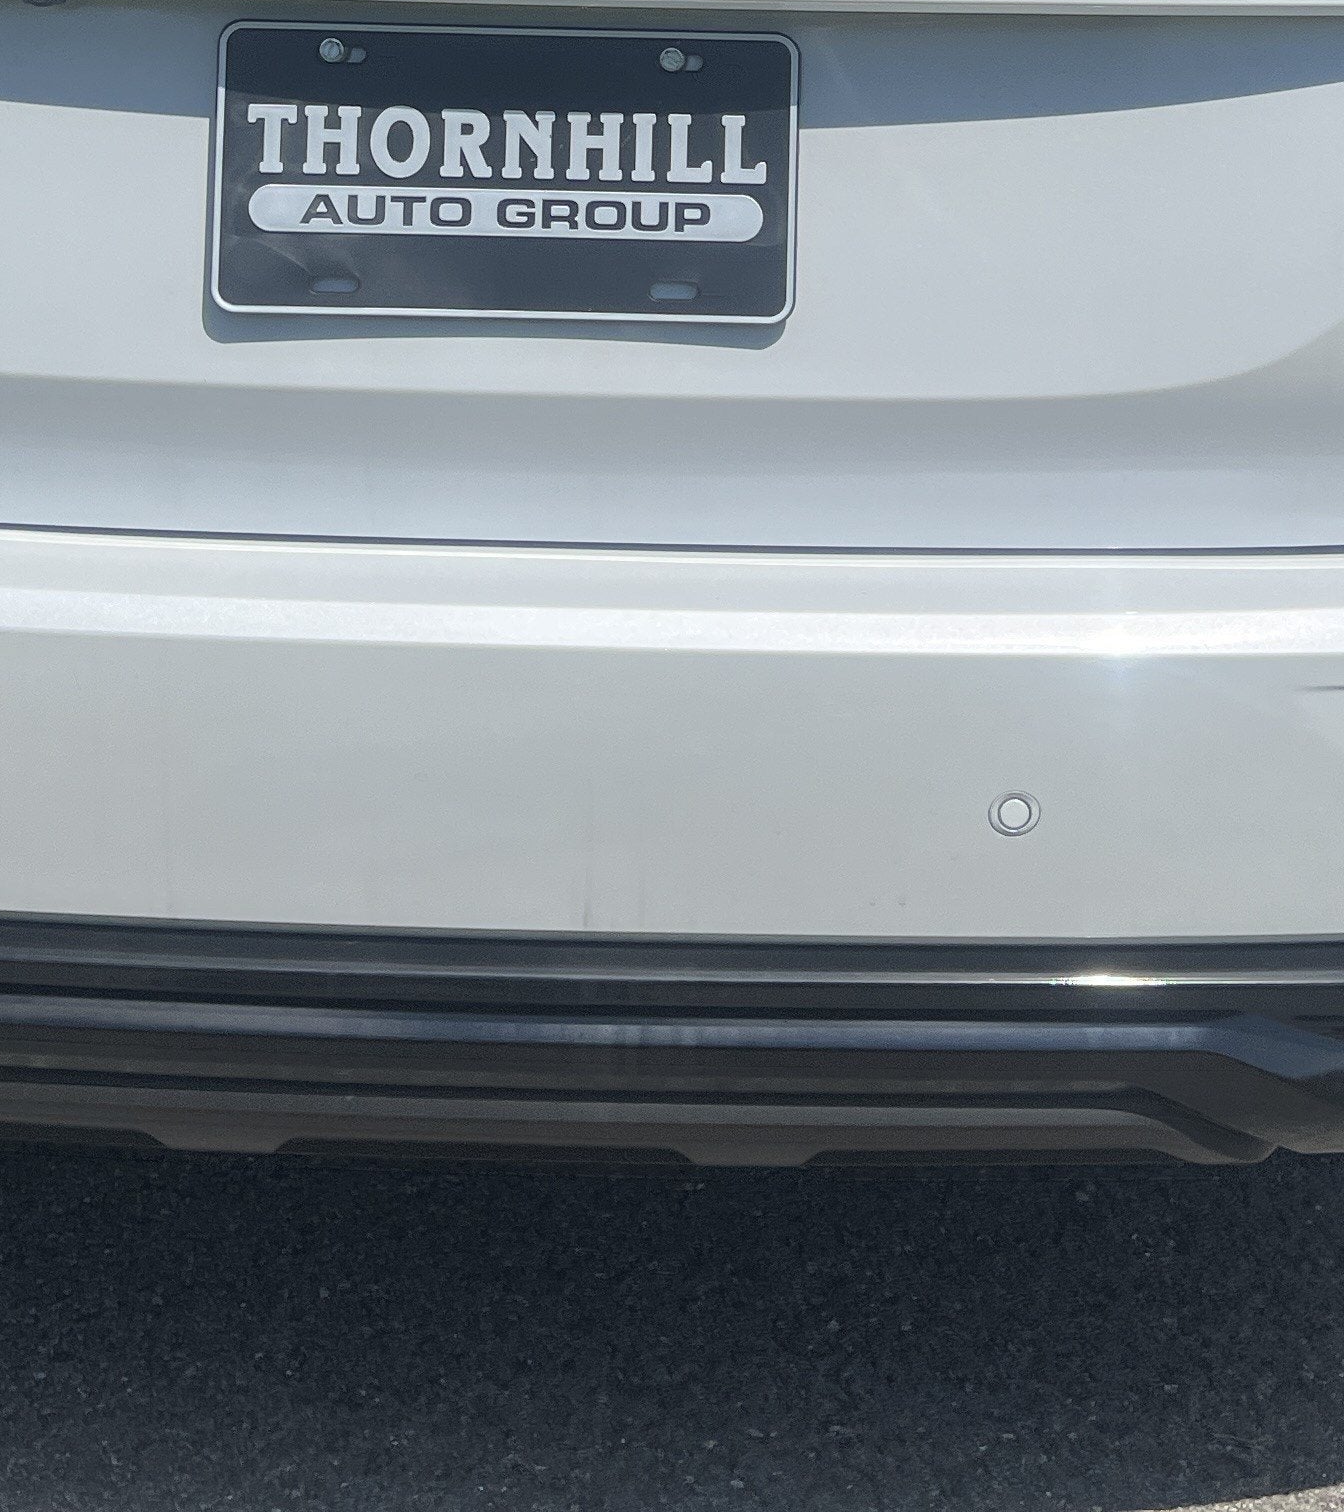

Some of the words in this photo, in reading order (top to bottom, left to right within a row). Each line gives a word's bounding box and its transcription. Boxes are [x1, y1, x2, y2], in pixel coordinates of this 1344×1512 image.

[247, 102, 767, 185] THORNHILL
[300, 194, 473, 228] AUTO
[496, 198, 712, 233] GROUP
